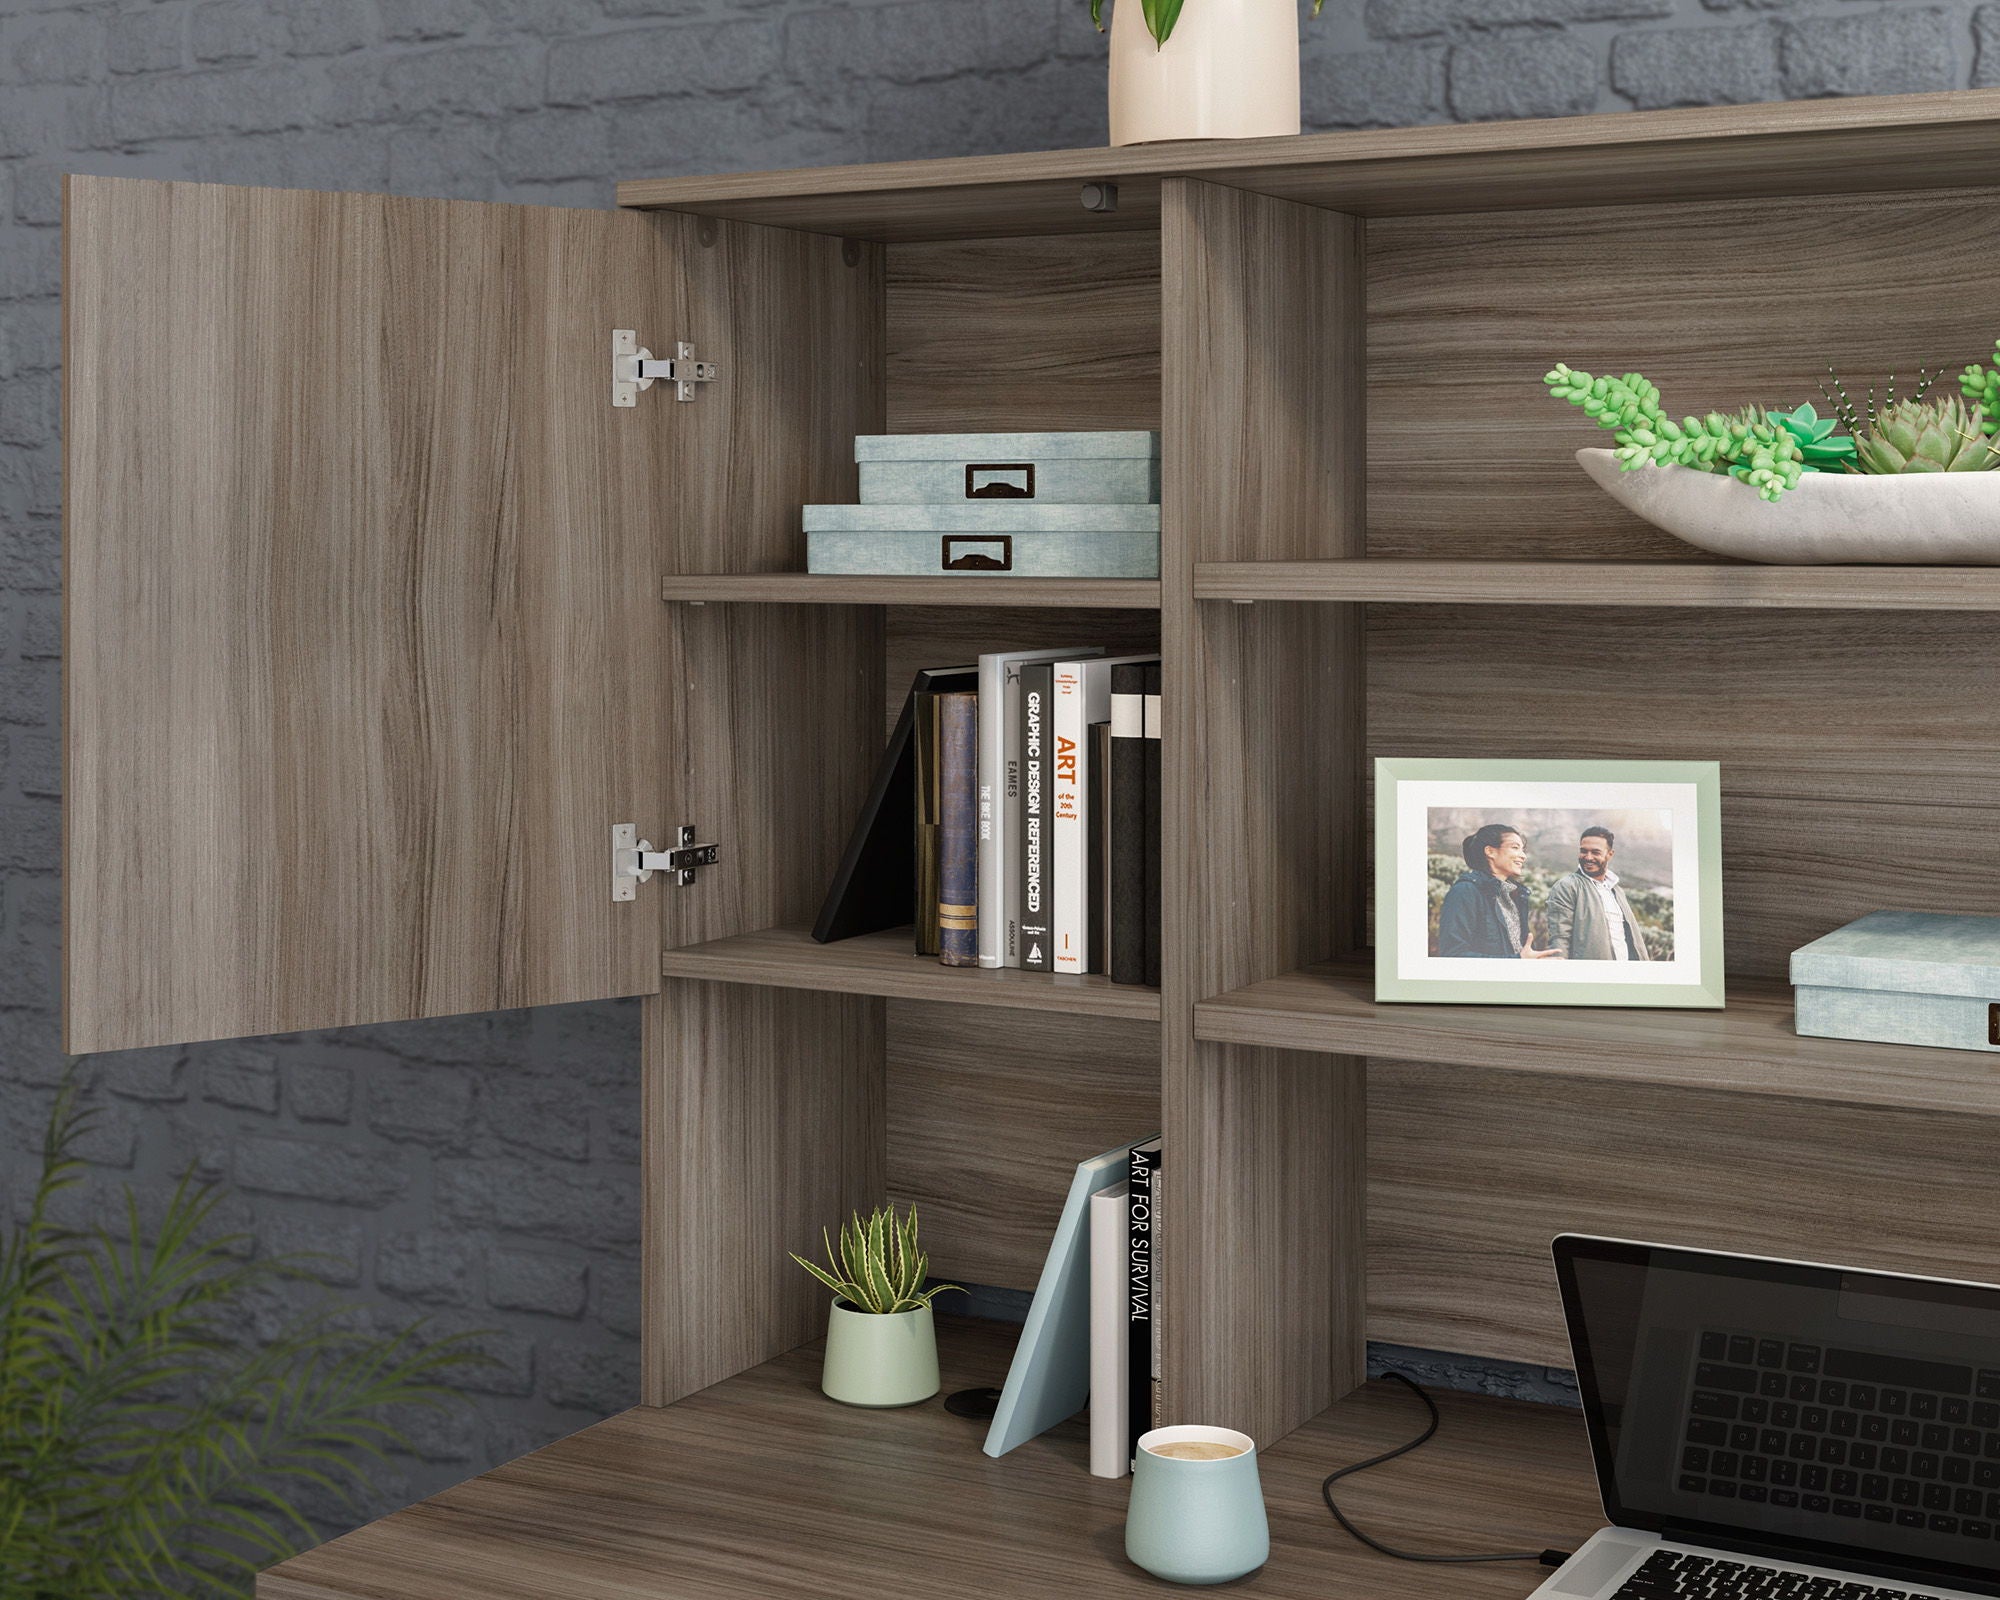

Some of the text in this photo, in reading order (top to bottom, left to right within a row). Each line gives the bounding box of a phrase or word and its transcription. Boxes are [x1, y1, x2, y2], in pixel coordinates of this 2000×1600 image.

[1027, 692, 1041, 757] GRAPHIC
[1007, 760, 1017, 798] EAMES
[1027, 760, 1041, 814] DESIGN
[1057, 735, 1076, 785] ART
[1055, 811, 1078, 821] Century
[1027, 818, 1041, 912] REFERENCED
[1131, 1151, 1149, 1321] ART FOR SURVIVAL
